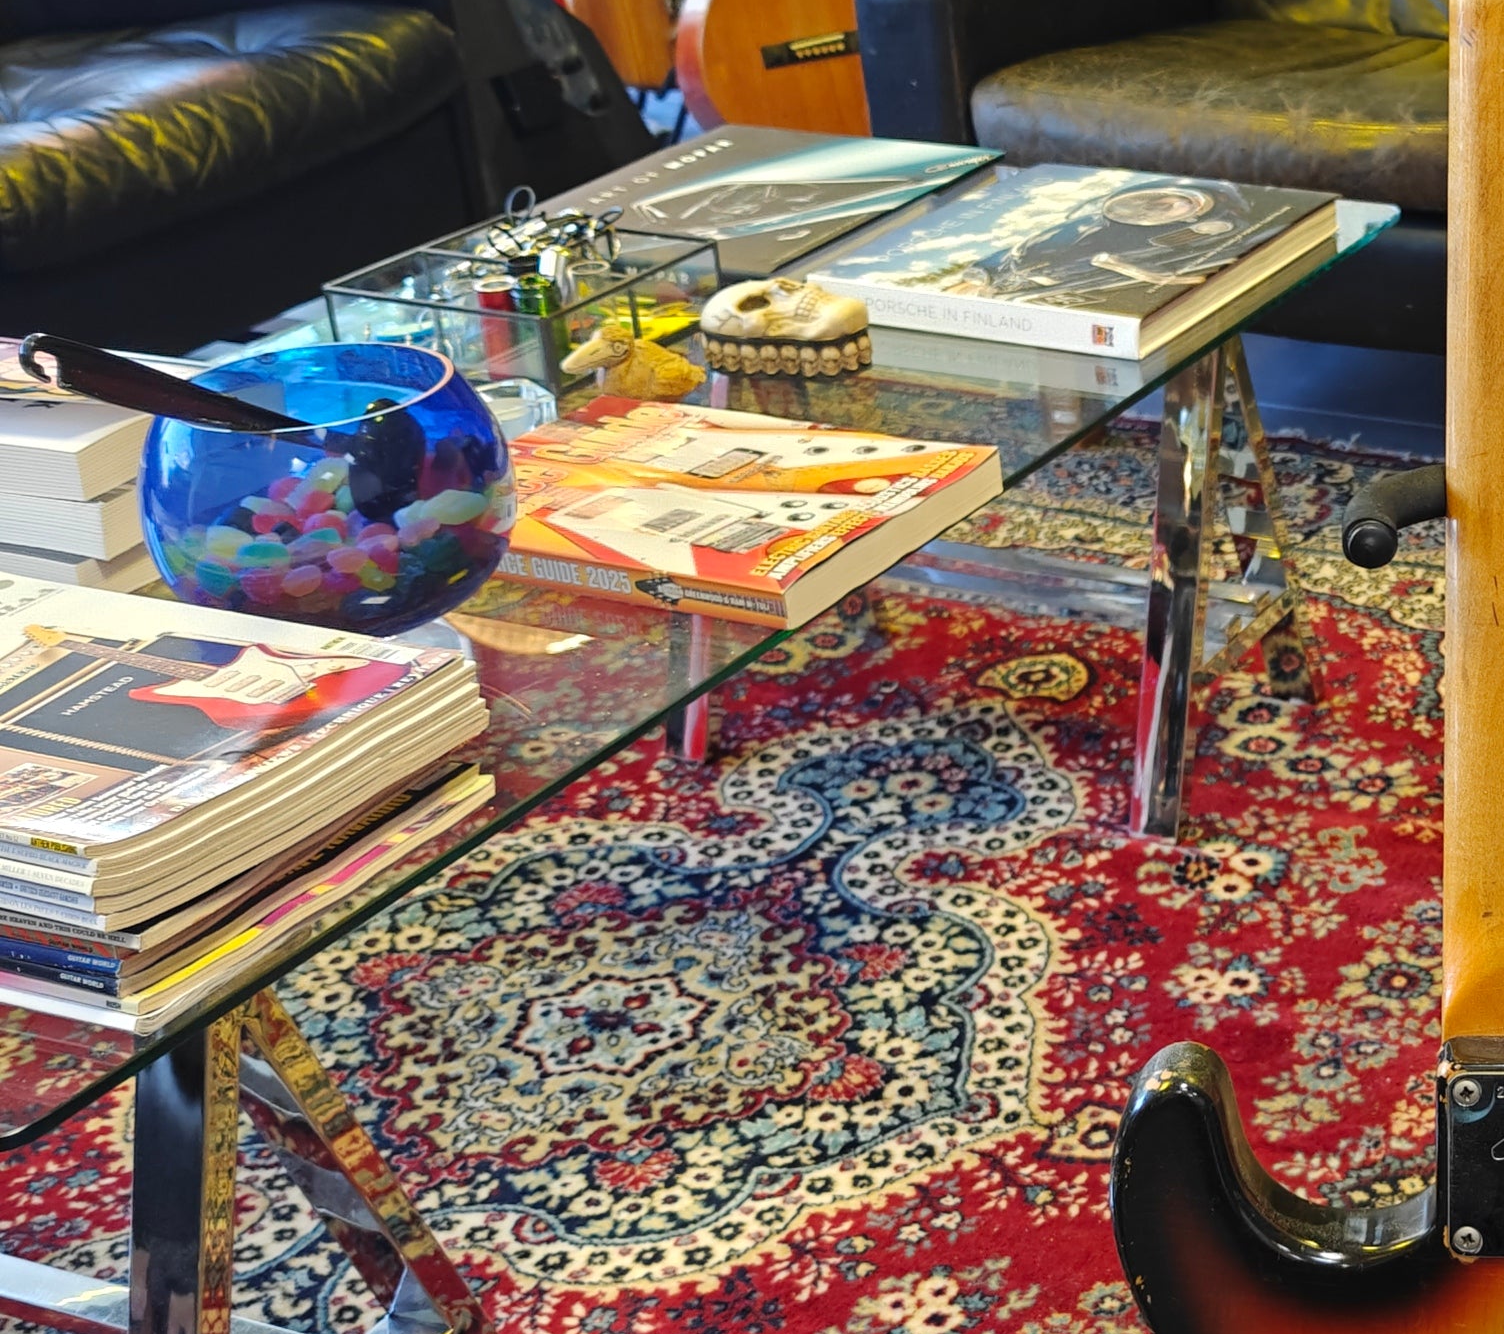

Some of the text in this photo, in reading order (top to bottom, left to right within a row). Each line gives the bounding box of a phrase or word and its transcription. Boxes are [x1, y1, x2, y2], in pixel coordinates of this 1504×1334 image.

[662, 139, 734, 170] MOPAR
[865, 298, 1033, 332] PORSCHE IN FINLAND
[531, 556, 583, 585] GUIDE
[586, 566, 632, 595] 2025
[60, 676, 134, 716] HAMSTEAD
[309, 691, 389, 740] TECHNIQUE
[9, 915, 37, 927] HEAVEN
[38, 921, 53, 930] AND
[54, 924, 71, 934] THIS
[72, 927, 96, 938] COULD
[107, 934, 126, 944] HELL
[67, 954, 116, 969] GUITAR WORLD
[60, 973, 104, 989] GUITAR WORLD
